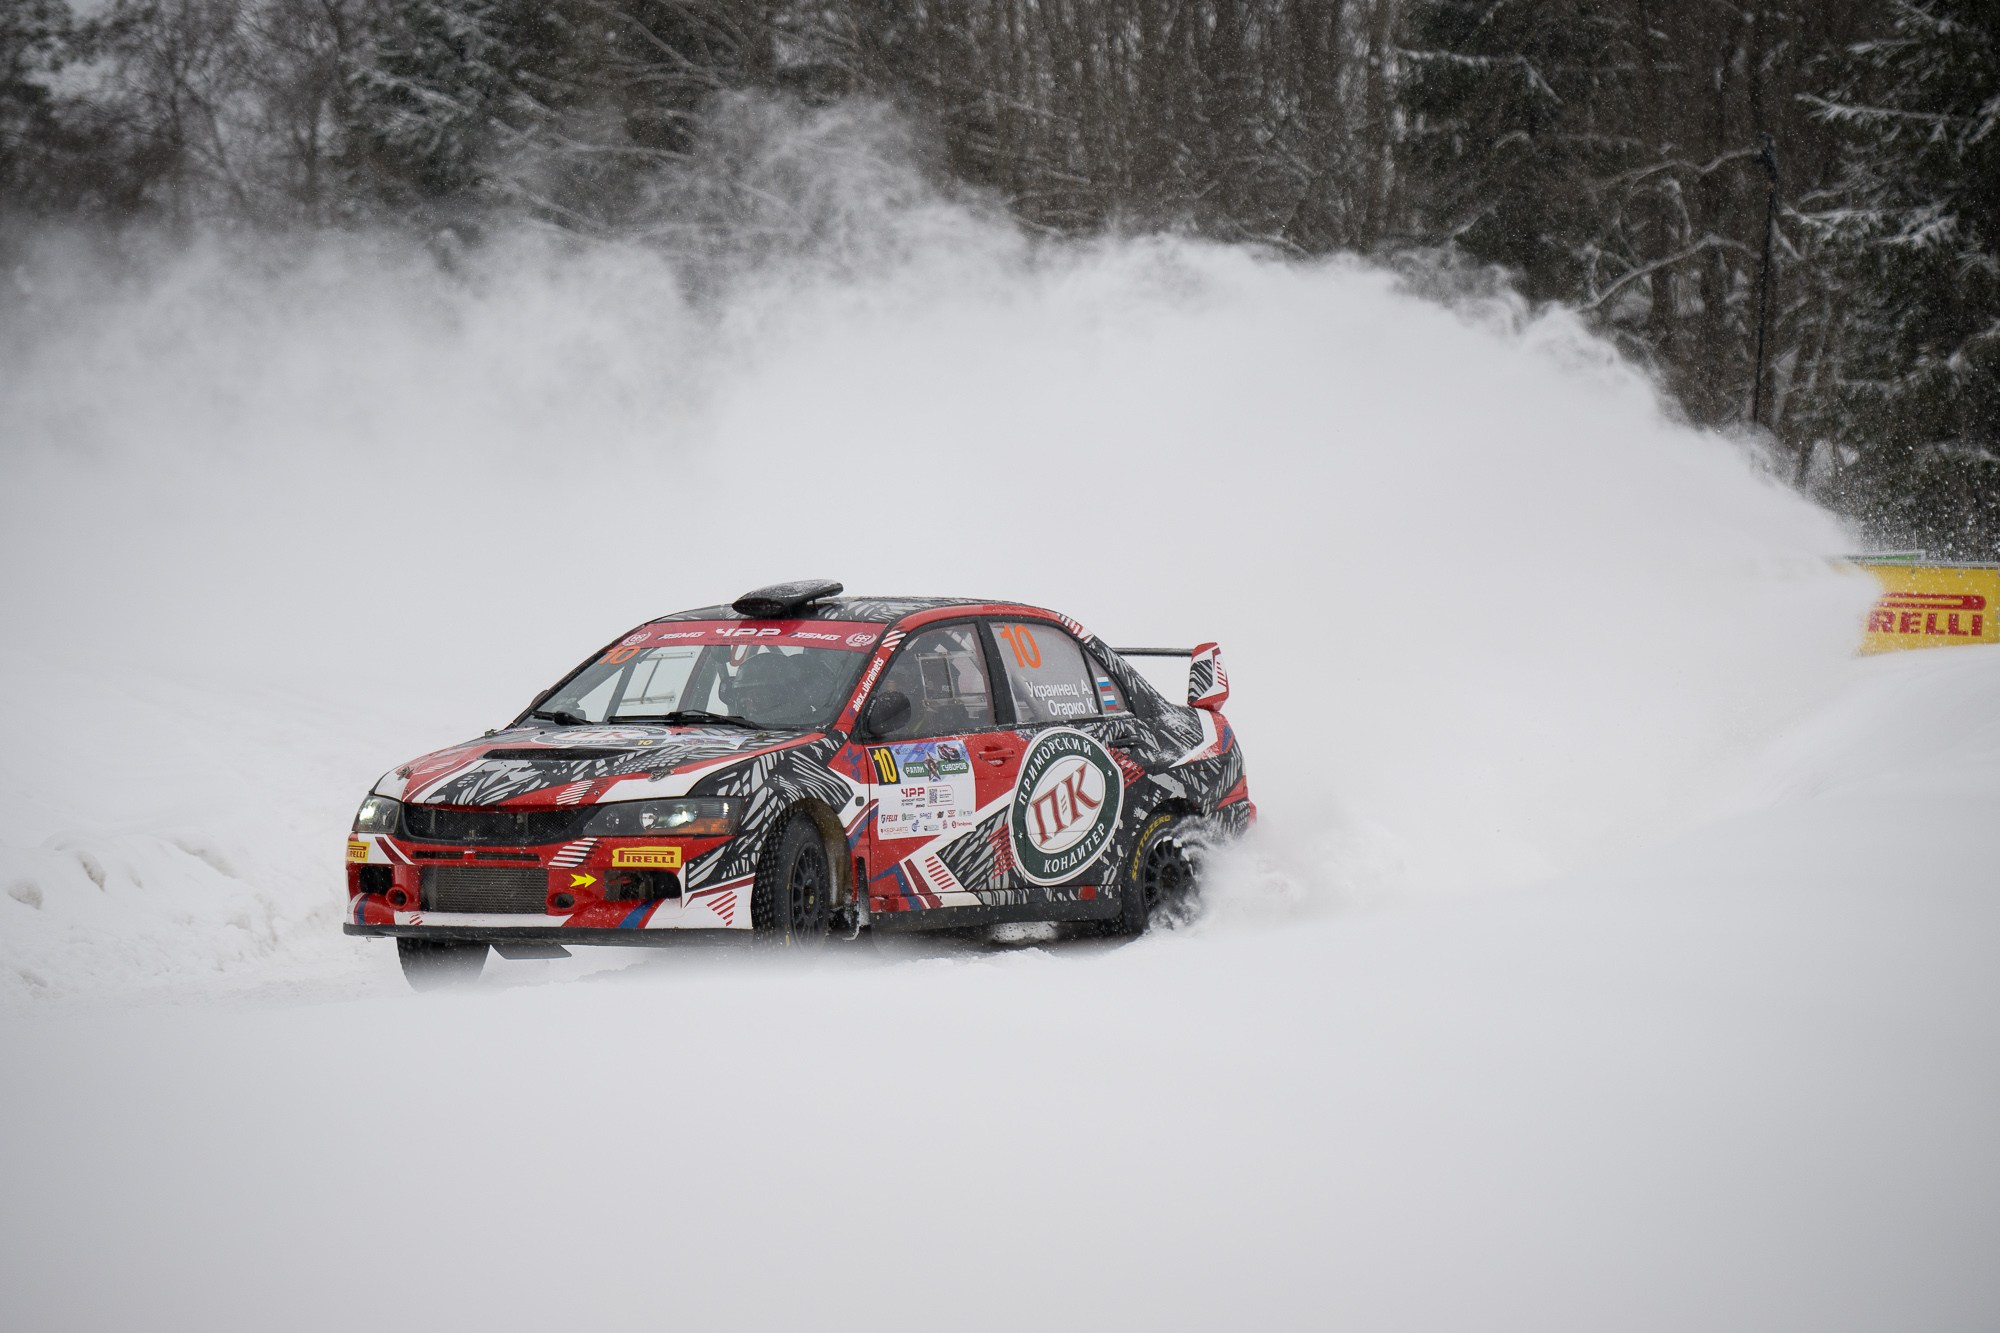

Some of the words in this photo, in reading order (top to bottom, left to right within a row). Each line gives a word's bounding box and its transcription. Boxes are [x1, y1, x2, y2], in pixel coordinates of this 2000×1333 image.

[1864, 592, 1987, 637] RELLI
[597, 645, 641, 665] 10
[1000, 624, 1042, 669] 10
[1026, 681, 1080, 701] Украинец
[1047, 699, 1086, 719] Огарко
[637, 739, 654, 747] 10
[873, 748, 898, 783] 10
[905, 765, 925, 775] РАЛЛИ
[940, 762, 968, 772] СУВОРОВ
[1018, 737, 1093, 806] ПРИМОРСКИЙ
[1029, 761, 1101, 847] ПК
[886, 814, 899, 823] FELIX
[617, 850, 676, 864] PIRELLI
[1043, 822, 1106, 873] КОНДИТЕР
